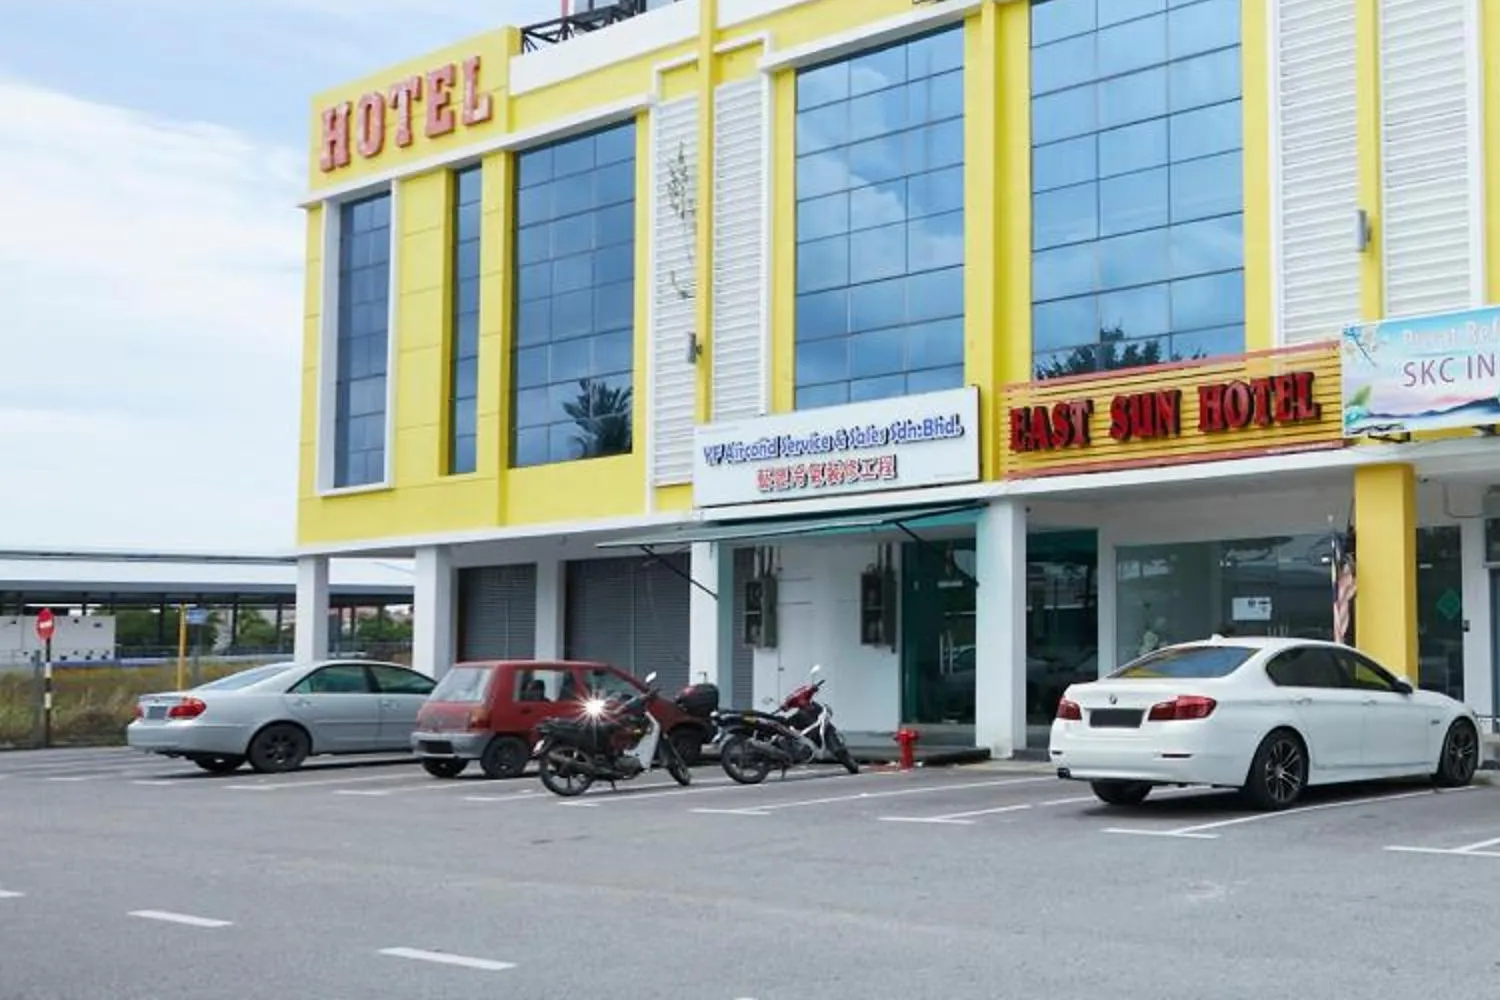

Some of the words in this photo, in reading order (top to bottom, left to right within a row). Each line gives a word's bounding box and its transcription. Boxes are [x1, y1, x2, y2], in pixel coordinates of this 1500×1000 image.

[319, 55, 493, 173] HOTEL
[1403, 357, 1456, 387] SKC
[1008, 399, 1095, 451] EAST
[1109, 388, 1182, 442] SUN
[1197, 371, 1321, 433] HOTEL
[725, 438, 778, 461] Aircond
[781, 432, 830, 455] Service
[850, 425, 888, 449] Sales
